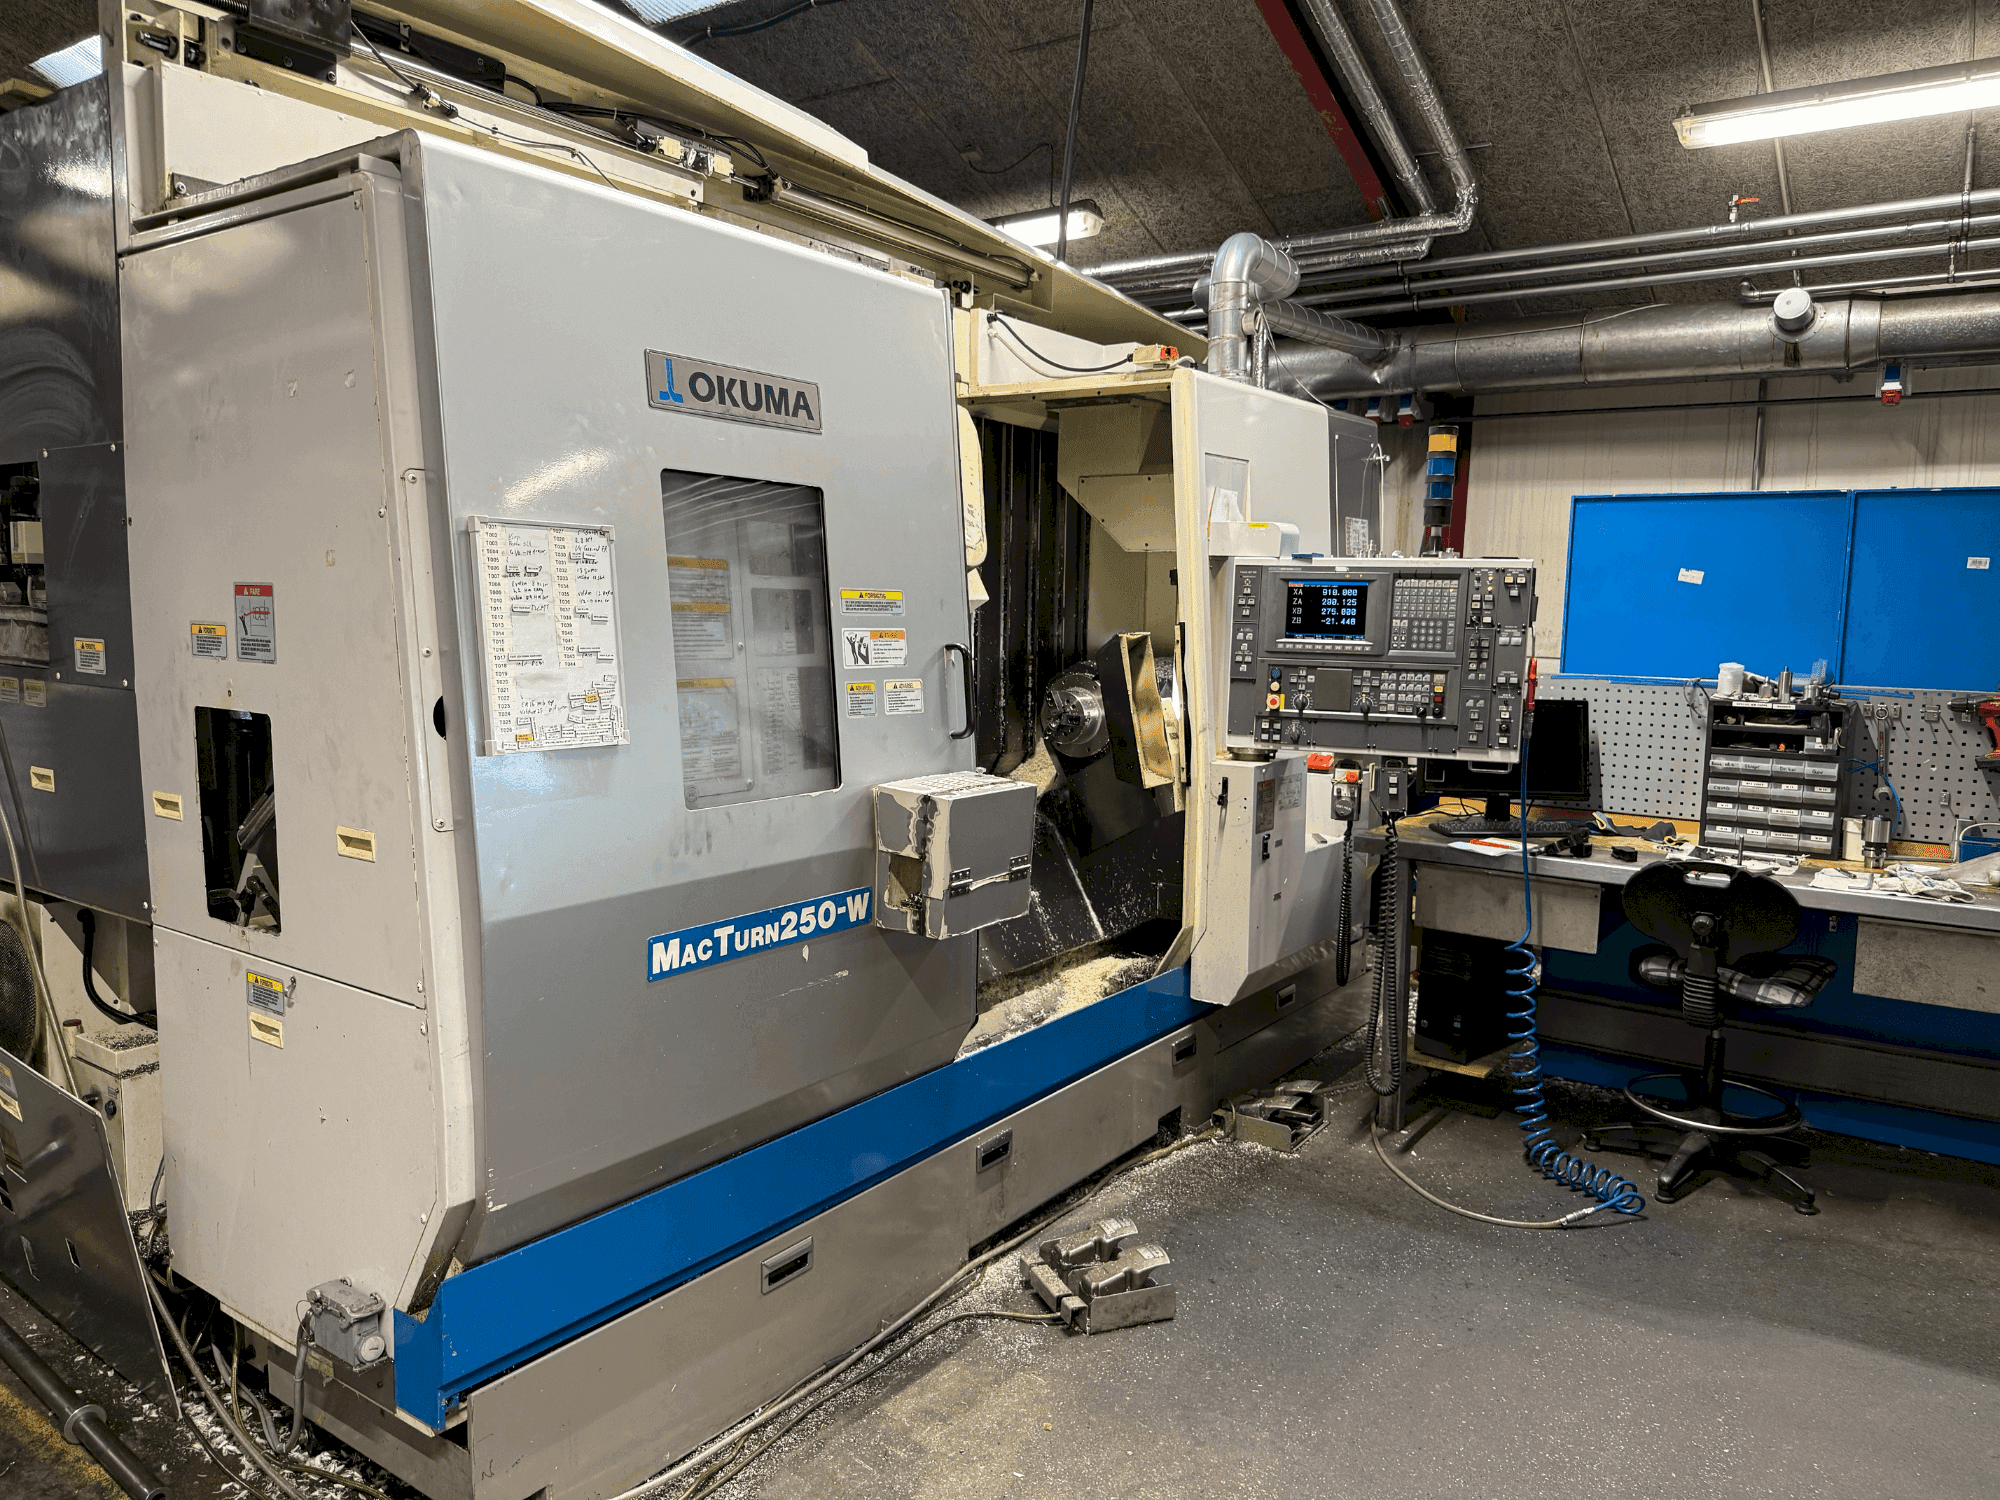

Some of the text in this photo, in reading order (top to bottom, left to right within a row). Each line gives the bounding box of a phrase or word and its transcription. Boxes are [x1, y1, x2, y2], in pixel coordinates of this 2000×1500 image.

[688, 371, 815, 421] OKUMA
[1293, 588, 1303, 596] XA
[1292, 597, 1303, 605] ZA
[1292, 607, 1302, 615] XB
[1291, 616, 1302, 624] ZB
